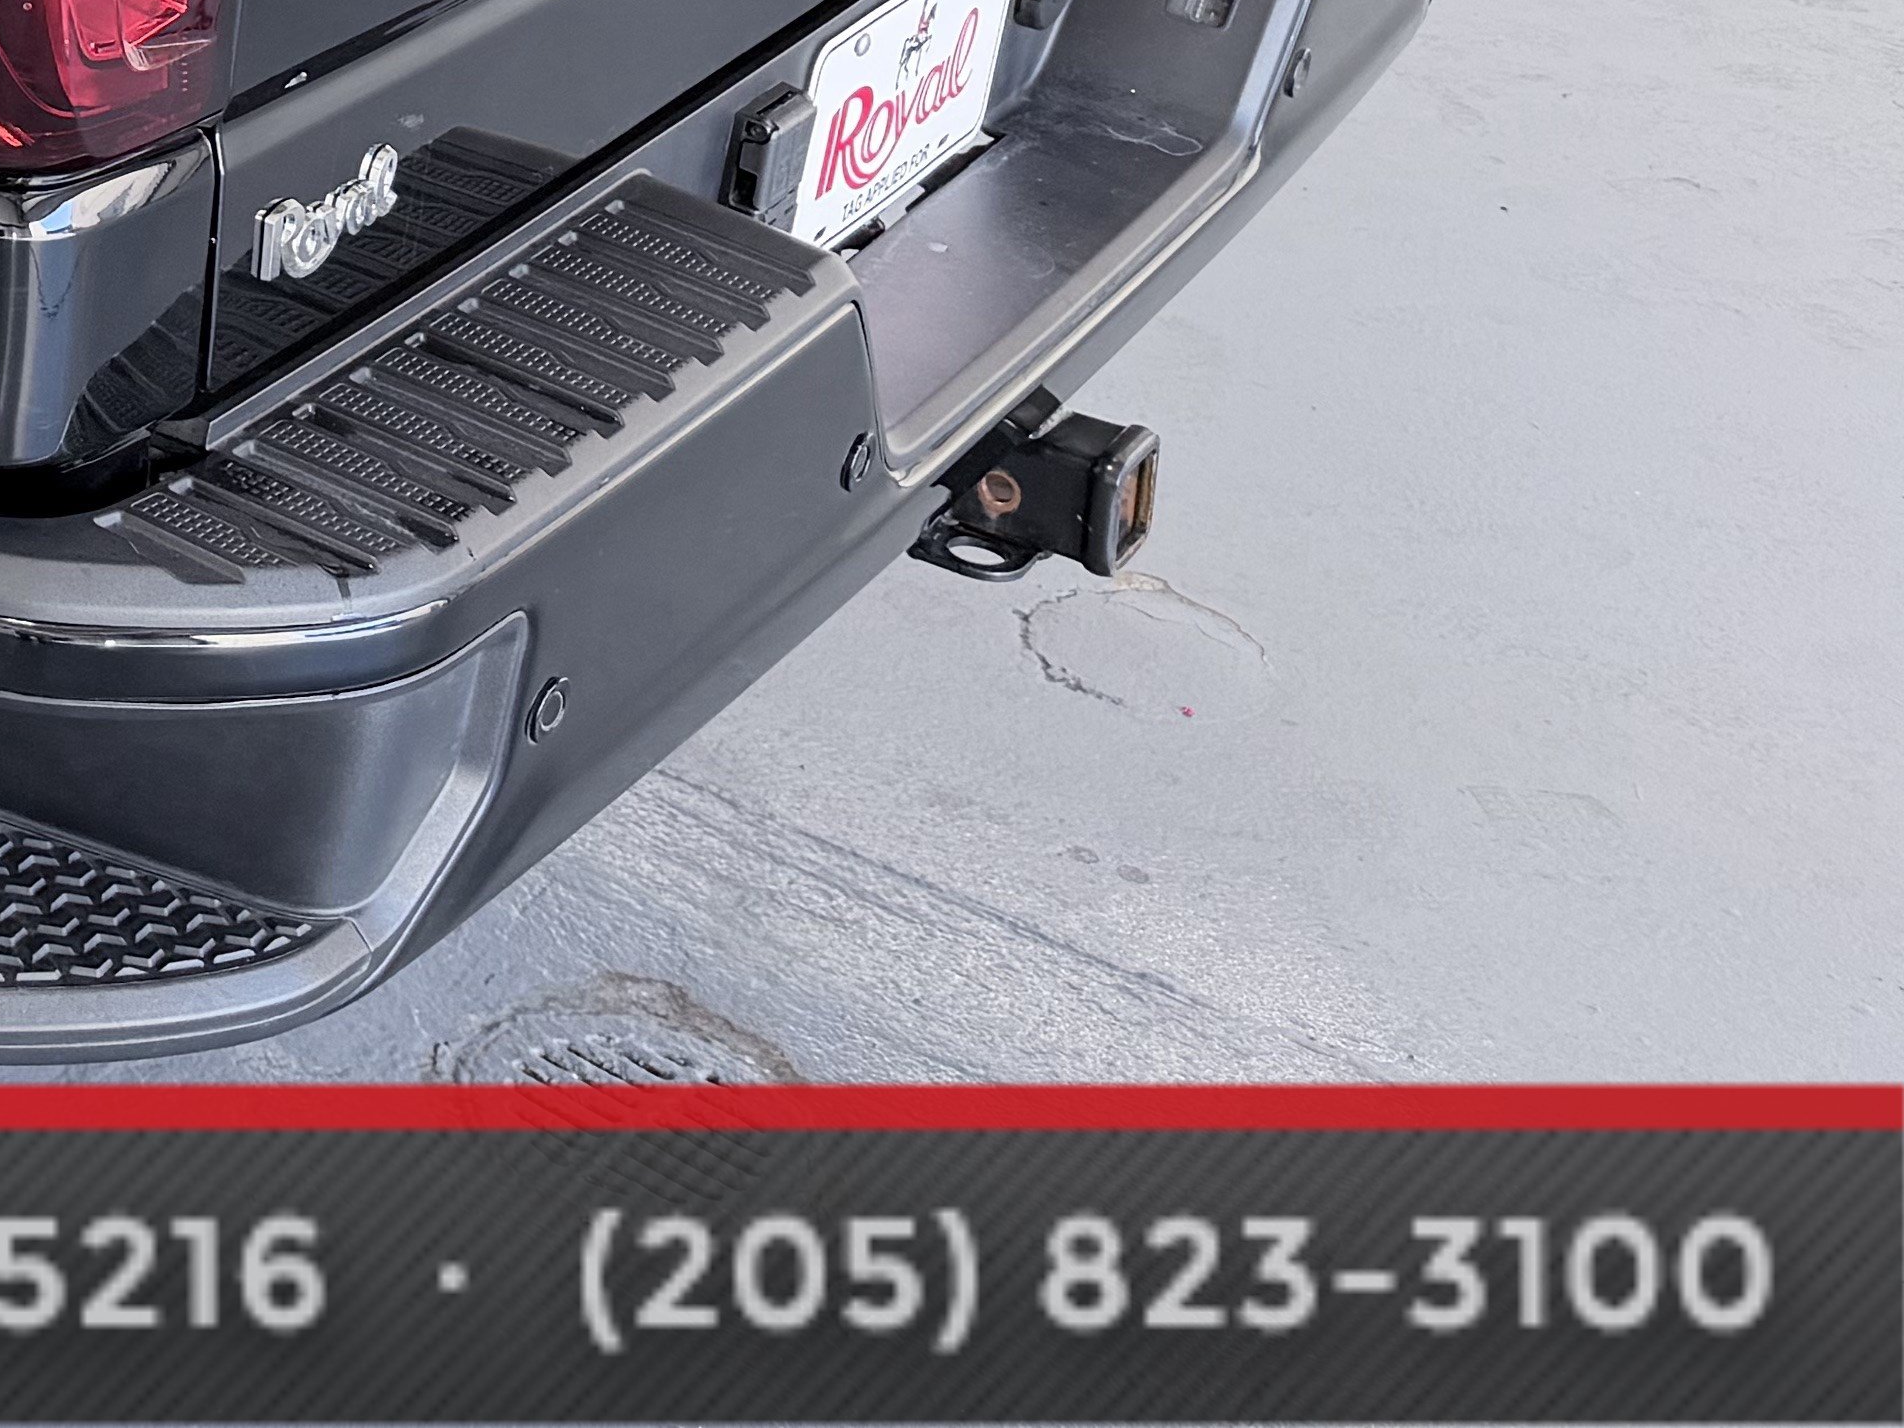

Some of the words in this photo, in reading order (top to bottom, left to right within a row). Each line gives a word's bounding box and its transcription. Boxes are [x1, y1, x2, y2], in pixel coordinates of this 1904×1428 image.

[814, 7, 980, 201] Royal
[250, 143, 398, 282] Royal
[863, 162, 908, 205] APPLIED
